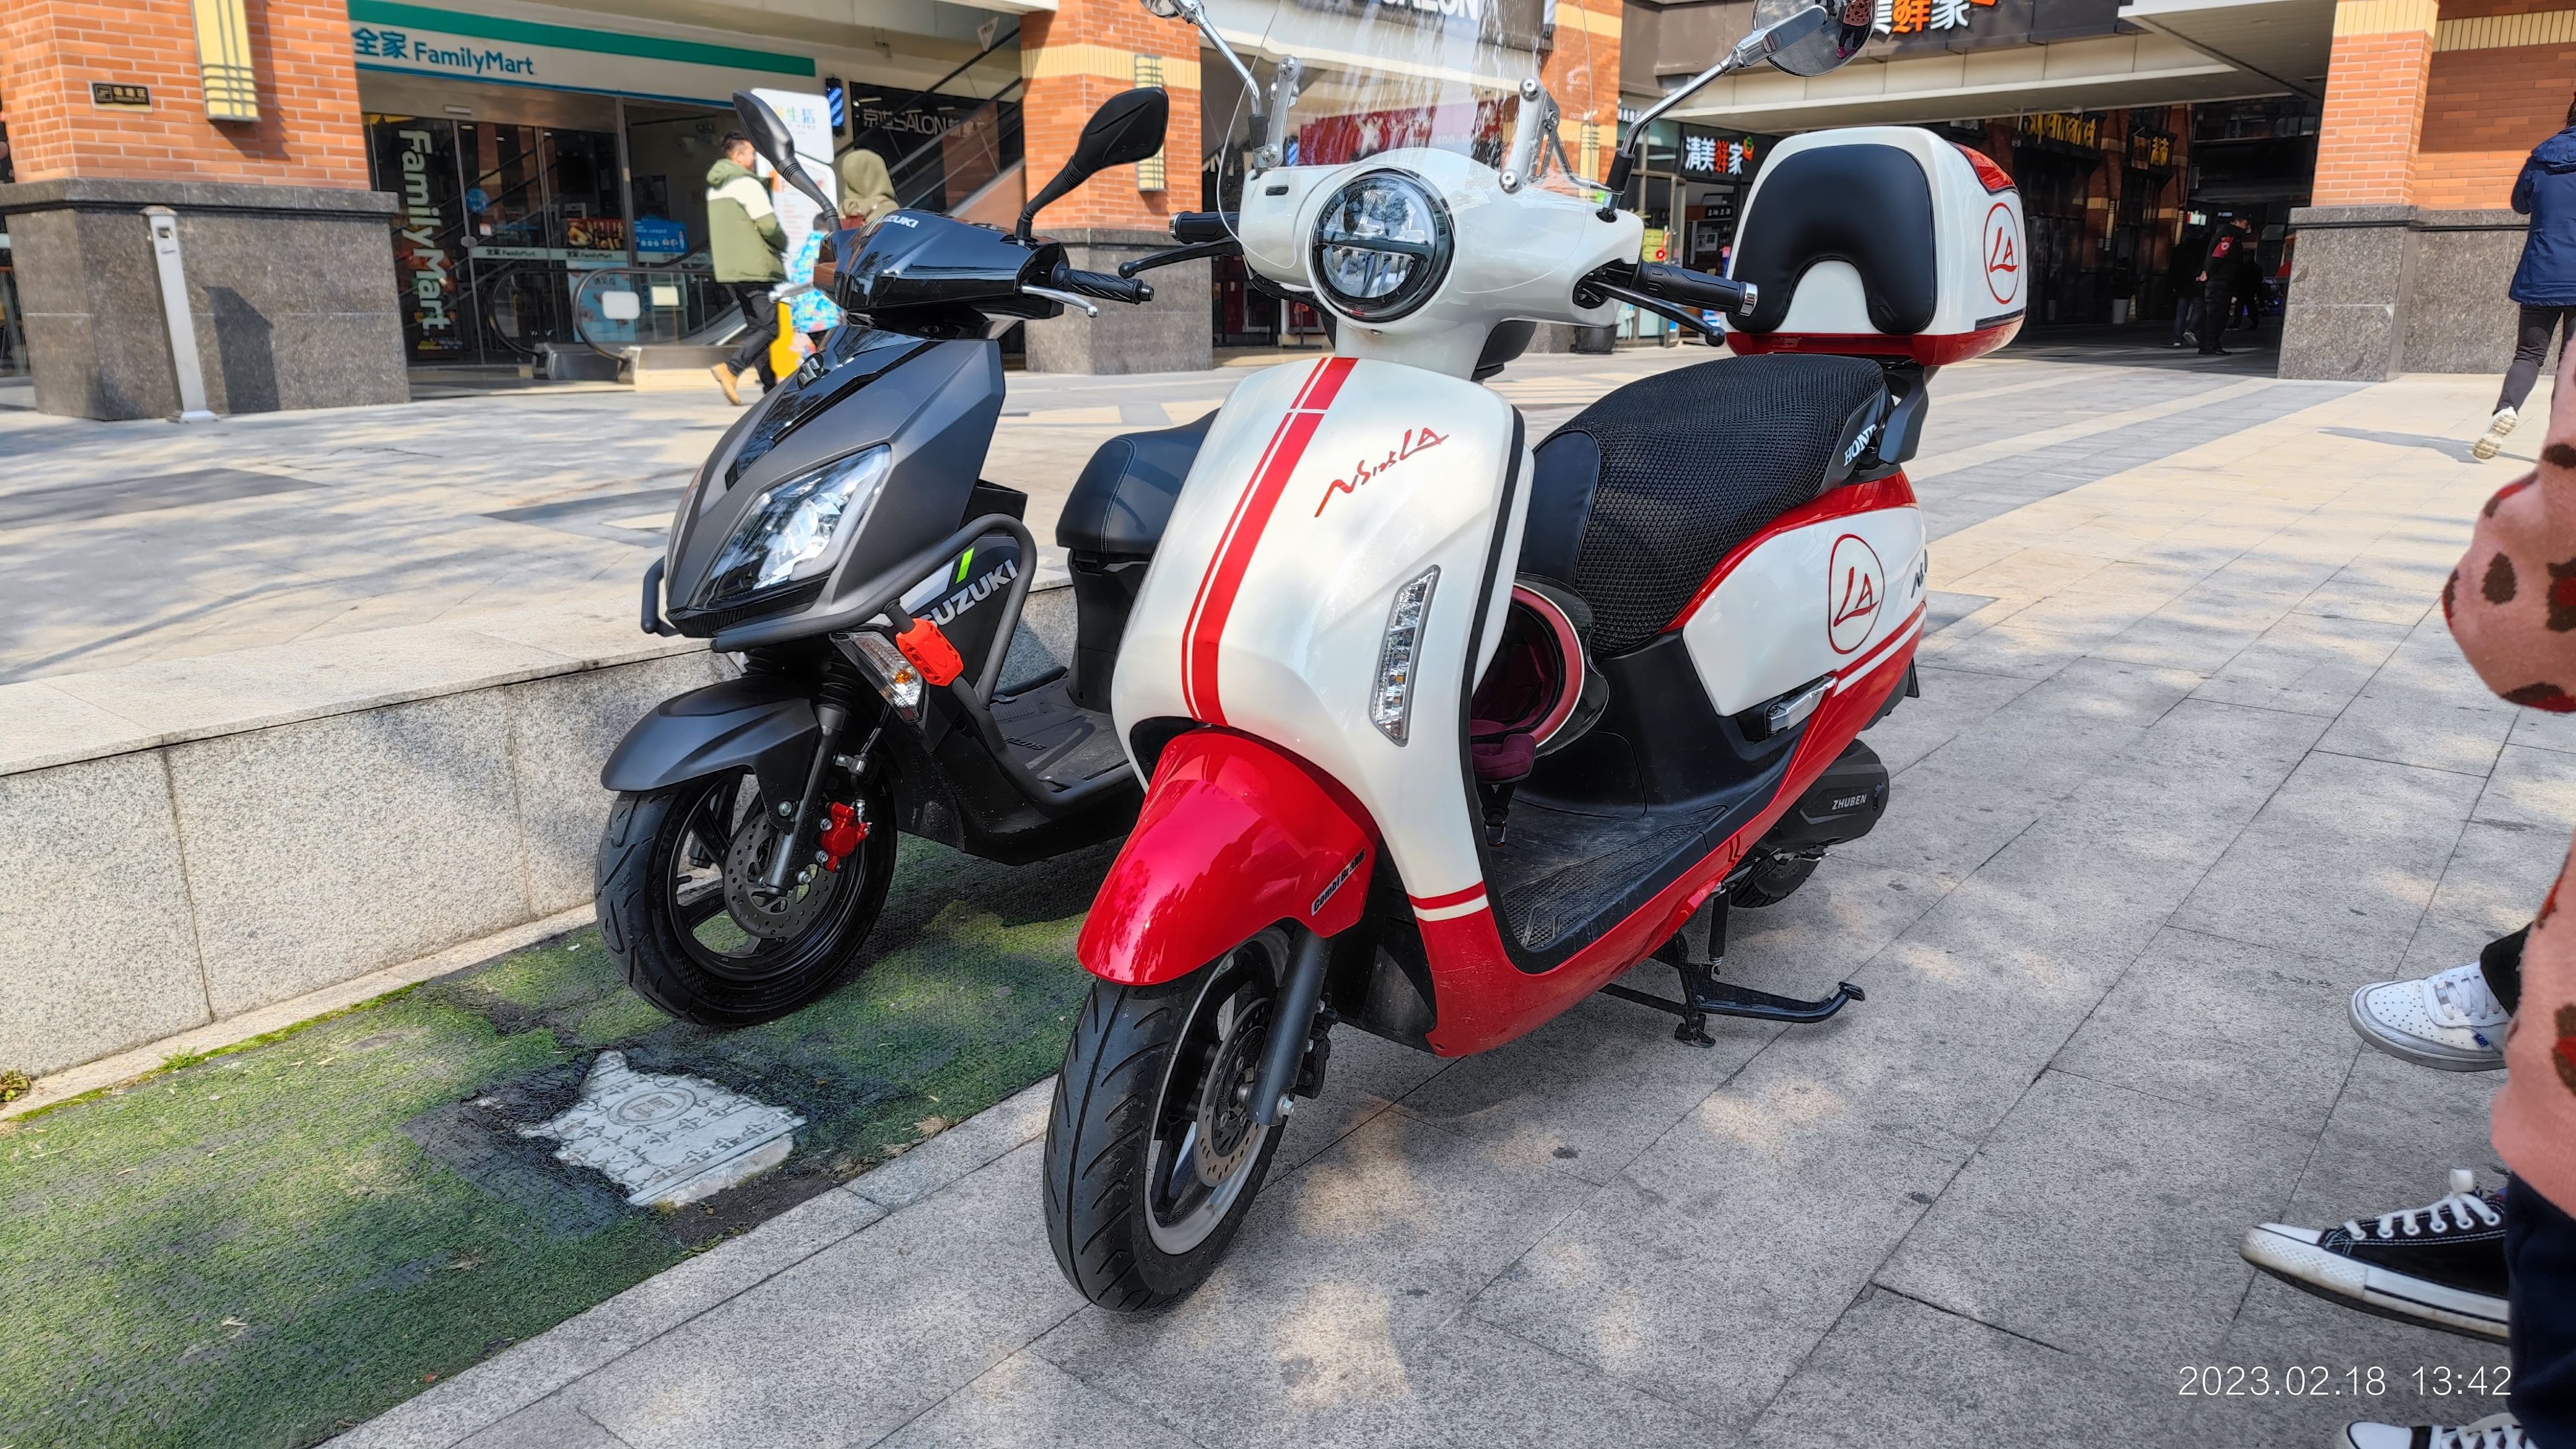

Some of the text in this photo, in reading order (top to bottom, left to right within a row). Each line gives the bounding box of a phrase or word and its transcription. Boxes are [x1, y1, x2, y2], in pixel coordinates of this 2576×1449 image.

[351, 27, 534, 75] 全家 FamilyMart
[1685, 135, 1744, 175] 清美鲜家
[399, 129, 452, 331] FamilyMart
[1989, 226, 2018, 274] LA
[1833, 566, 1880, 628] LA
[1831, 793, 1868, 811] ZHUBEN
[1314, 874, 1341, 912] Combi
